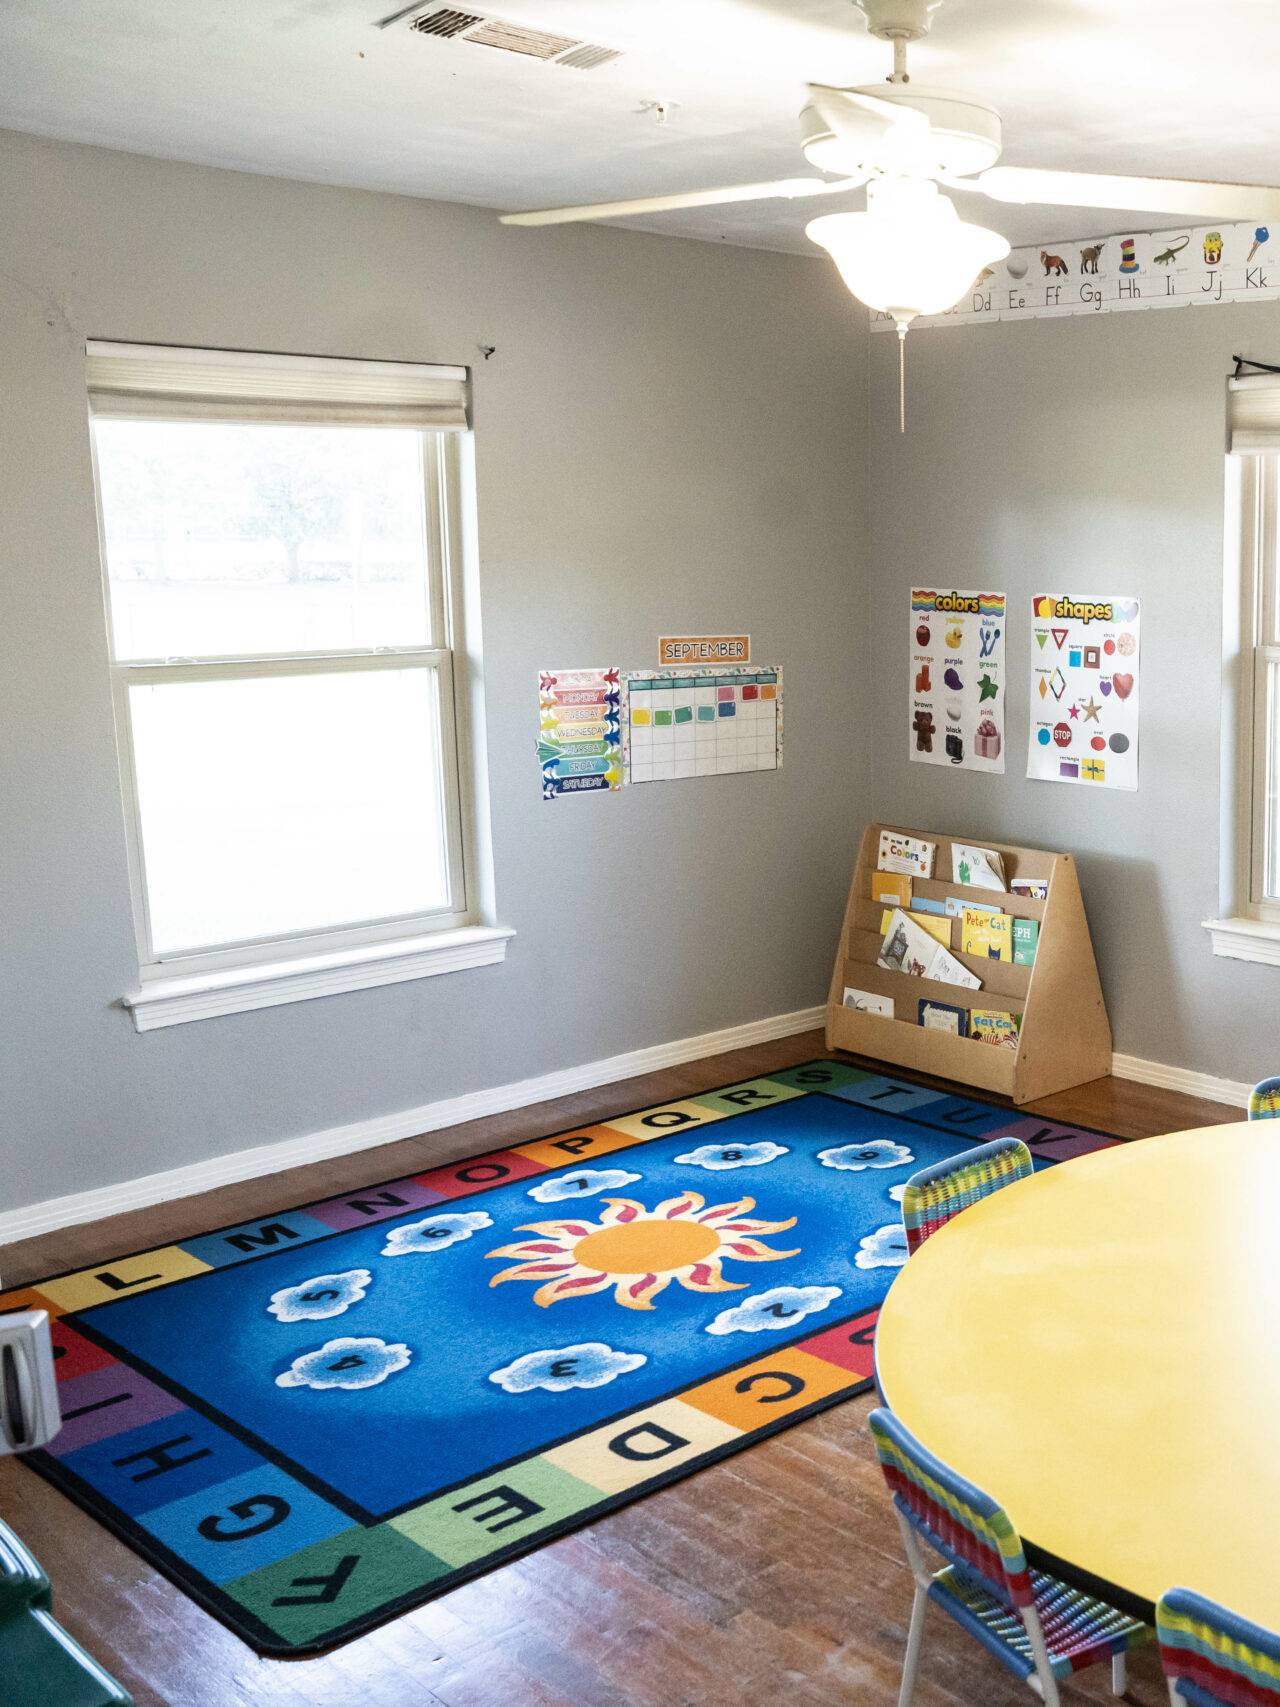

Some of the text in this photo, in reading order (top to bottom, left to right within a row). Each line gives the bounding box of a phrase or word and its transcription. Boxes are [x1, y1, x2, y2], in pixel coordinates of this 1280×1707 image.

[973, 292, 991, 312] Dd
[1008, 289, 1026, 309] Ee
[1045, 286, 1062, 306] Ff
[1079, 283, 1102, 312] Gg
[1118, 278, 1141, 299] Hh
[1165, 275, 1175, 296] Ii
[1201, 270, 1223, 300] Jj
[1245, 267, 1268, 289] Kk
[935, 591, 980, 614] colors
[1055, 596, 1112, 624] shapes
[918, 614, 930, 622] red
[982, 618, 995, 627] blue
[665, 641, 744, 658] SEPTEMBER
[944, 657, 963, 666] purple
[979, 660, 998, 669] green
[914, 700, 934, 709] brown
[980, 708, 994, 717] pink
[557, 726, 606, 738] WEDNESDAY
[945, 725, 962, 734] black
[1054, 730, 1071, 740] STOP
[568, 760, 598, 772] FRIDAY
[890, 845, 919, 862] Colors
[966, 911, 1006, 931] Pete Cat
[794, 1069, 833, 1084] S
[718, 1088, 777, 1106] R
[869, 1085, 916, 1101] T
[640, 1110, 701, 1128] Q
[942, 1106, 993, 1124] U
[551, 1136, 604, 1155] P
[1034, 1127, 1077, 1148] V
[720, 1151, 742, 1162] 8
[454, 1163, 511, 1183] O
[565, 1178, 589, 1191] 7
[346, 1191, 411, 1216] N
[224, 1222, 301, 1253] M
[421, 1226, 451, 1240] 6
[94, 1268, 163, 1291] L
[302, 1288, 340, 1305] 5
[761, 1301, 799, 1321] 2
[327, 1353, 367, 1371] 4
[550, 1359, 579, 1377] 3
[735, 1370, 806, 1403] C
[607, 1423, 692, 1462] D
[112, 1434, 212, 1483] H
[199, 1494, 291, 1542] G
[451, 1485, 547, 1533] E
[270, 1555, 361, 1609] F
